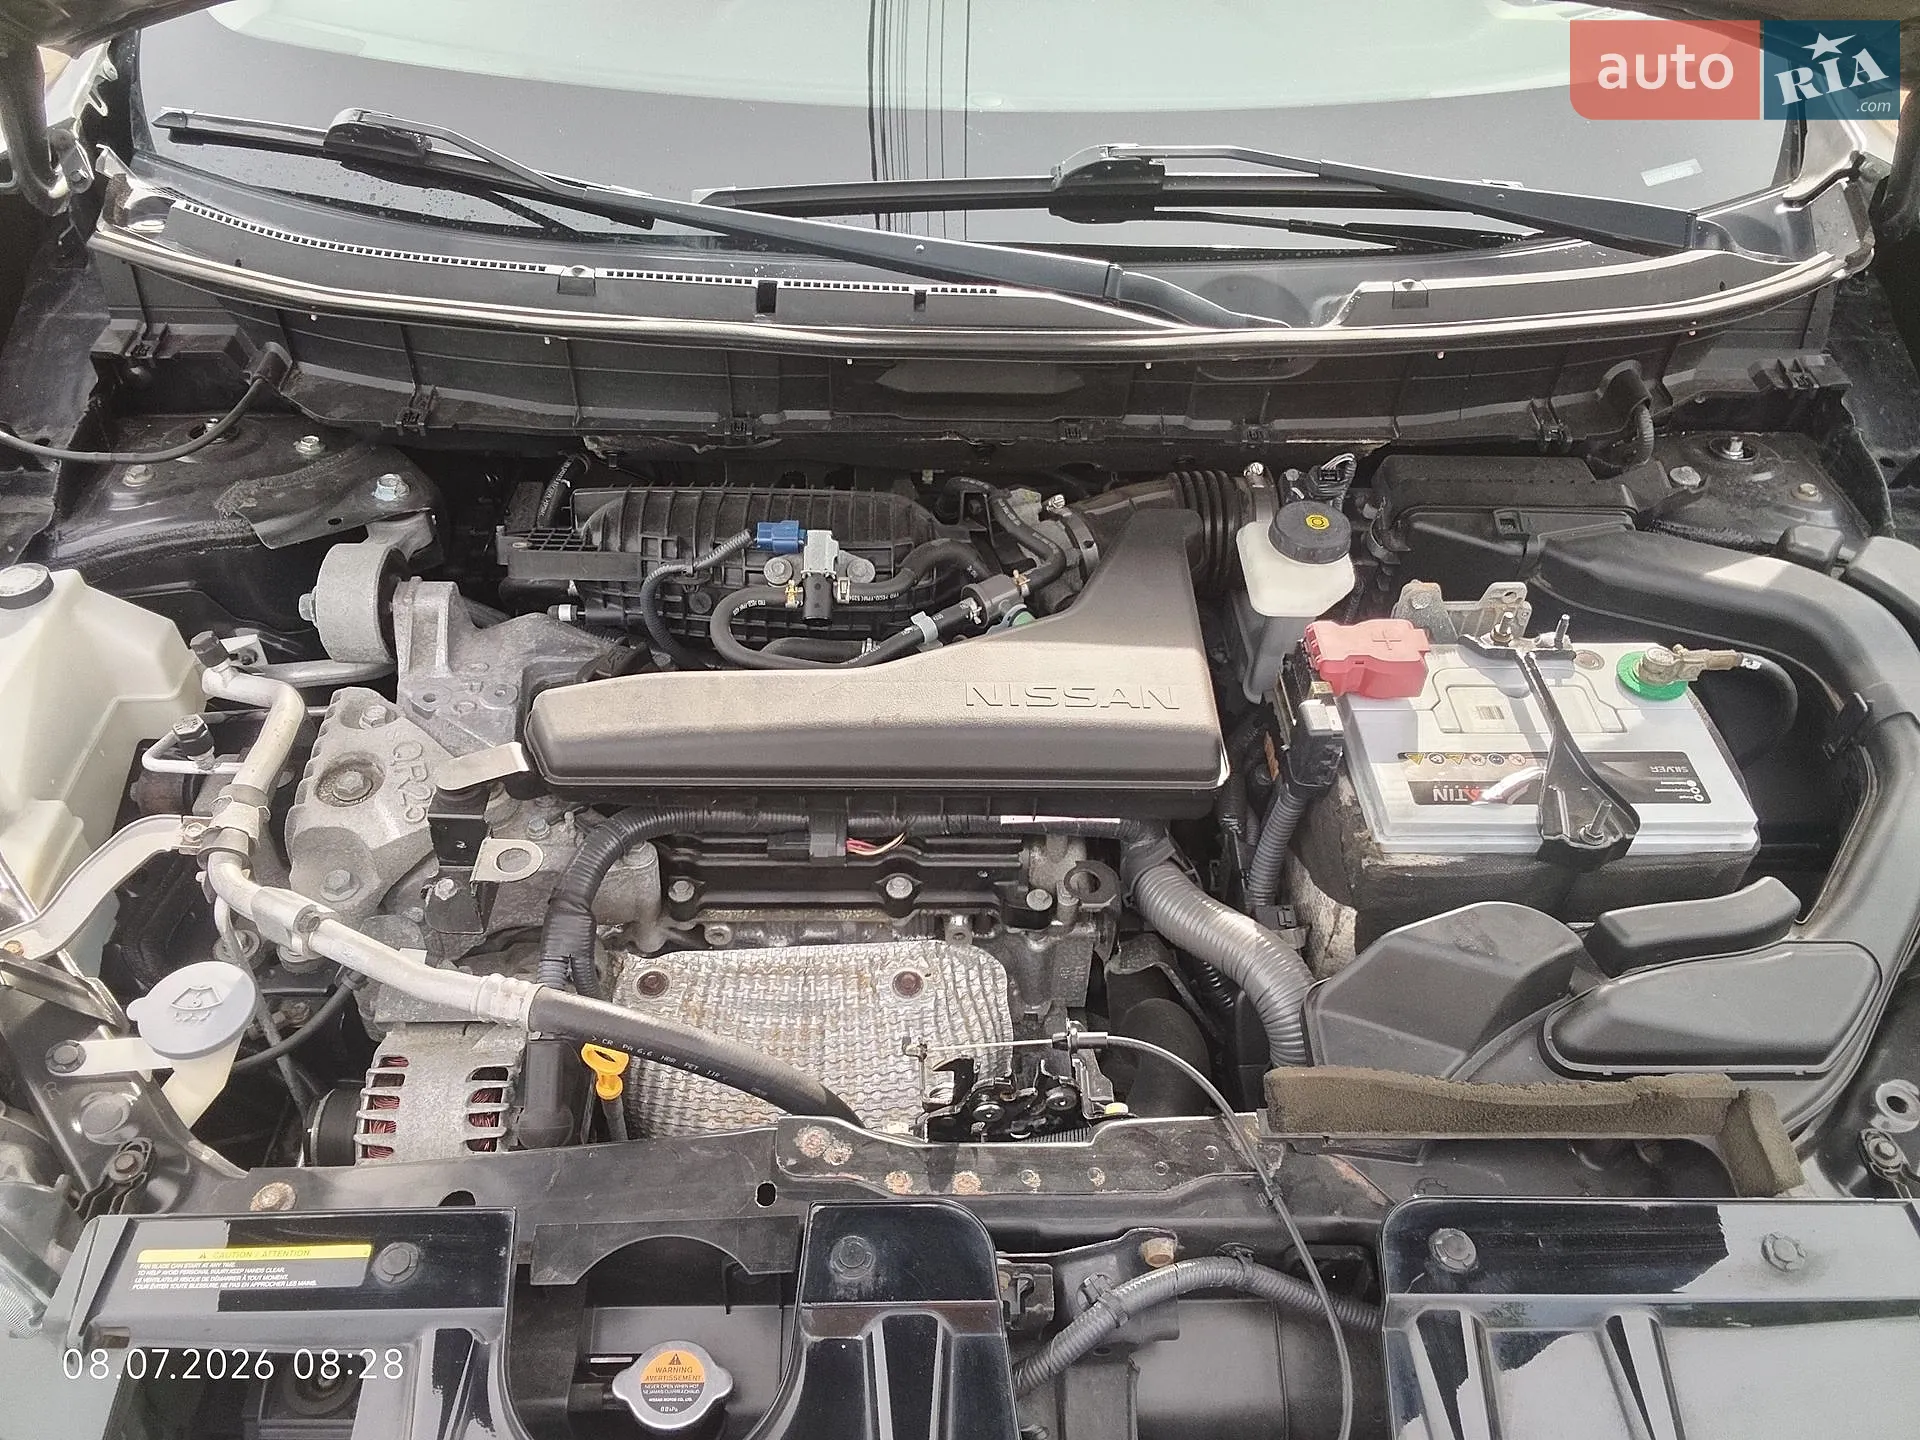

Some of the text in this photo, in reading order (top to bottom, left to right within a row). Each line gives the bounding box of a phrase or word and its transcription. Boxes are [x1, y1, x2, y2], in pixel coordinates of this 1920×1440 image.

[965, 682, 1180, 710] NISSAN
[1649, 765, 1689, 774] SILVER
[390, 741, 433, 823] QR25
[684, 1062, 699, 1071] PET
[213, 1251, 252, 1259] CAUTION
[262, 1249, 310, 1257] ATTENTION
[655, 1366, 693, 1374] WARNING
